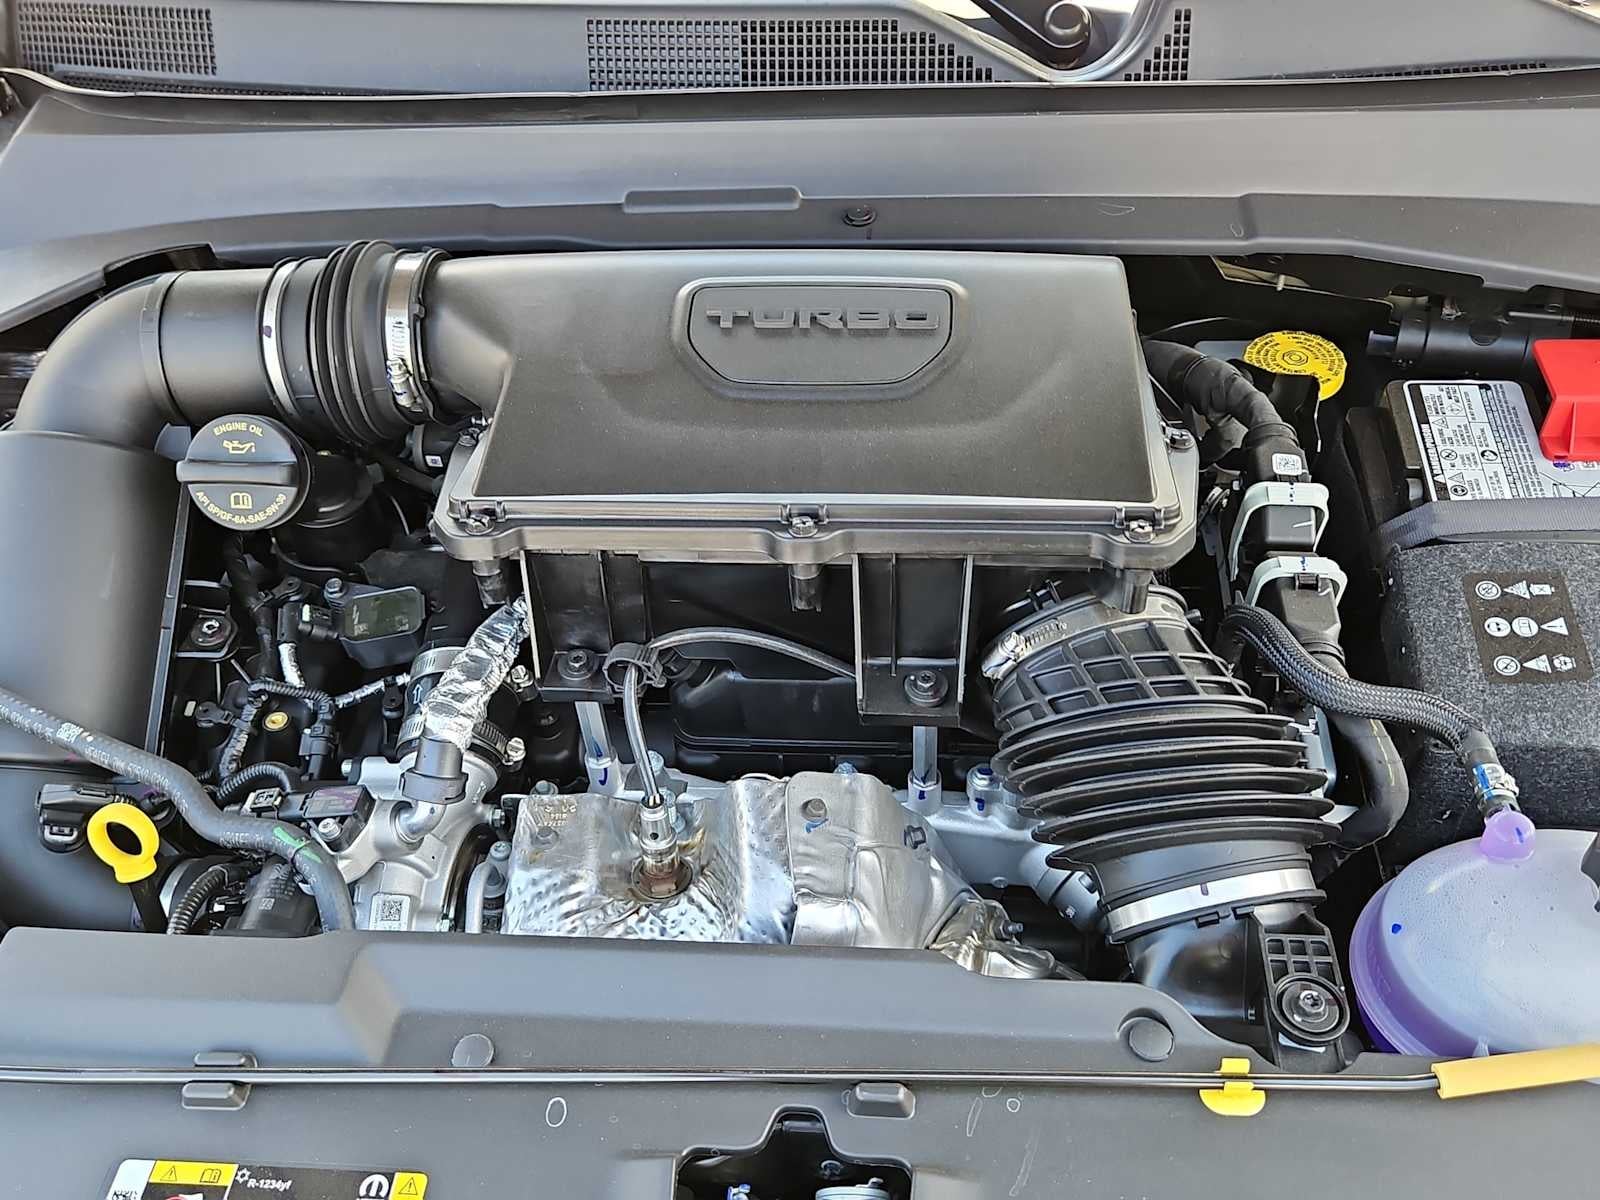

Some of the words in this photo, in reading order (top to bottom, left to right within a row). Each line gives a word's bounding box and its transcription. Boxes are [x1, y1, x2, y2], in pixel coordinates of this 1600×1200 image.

[706, 306, 939, 331] TURBO
[213, 422, 247, 436] ENGINE
[249, 423, 264, 437] OIL
[195, 491, 209, 507] API
[247, 1179, 292, 1192] R-1234yf
